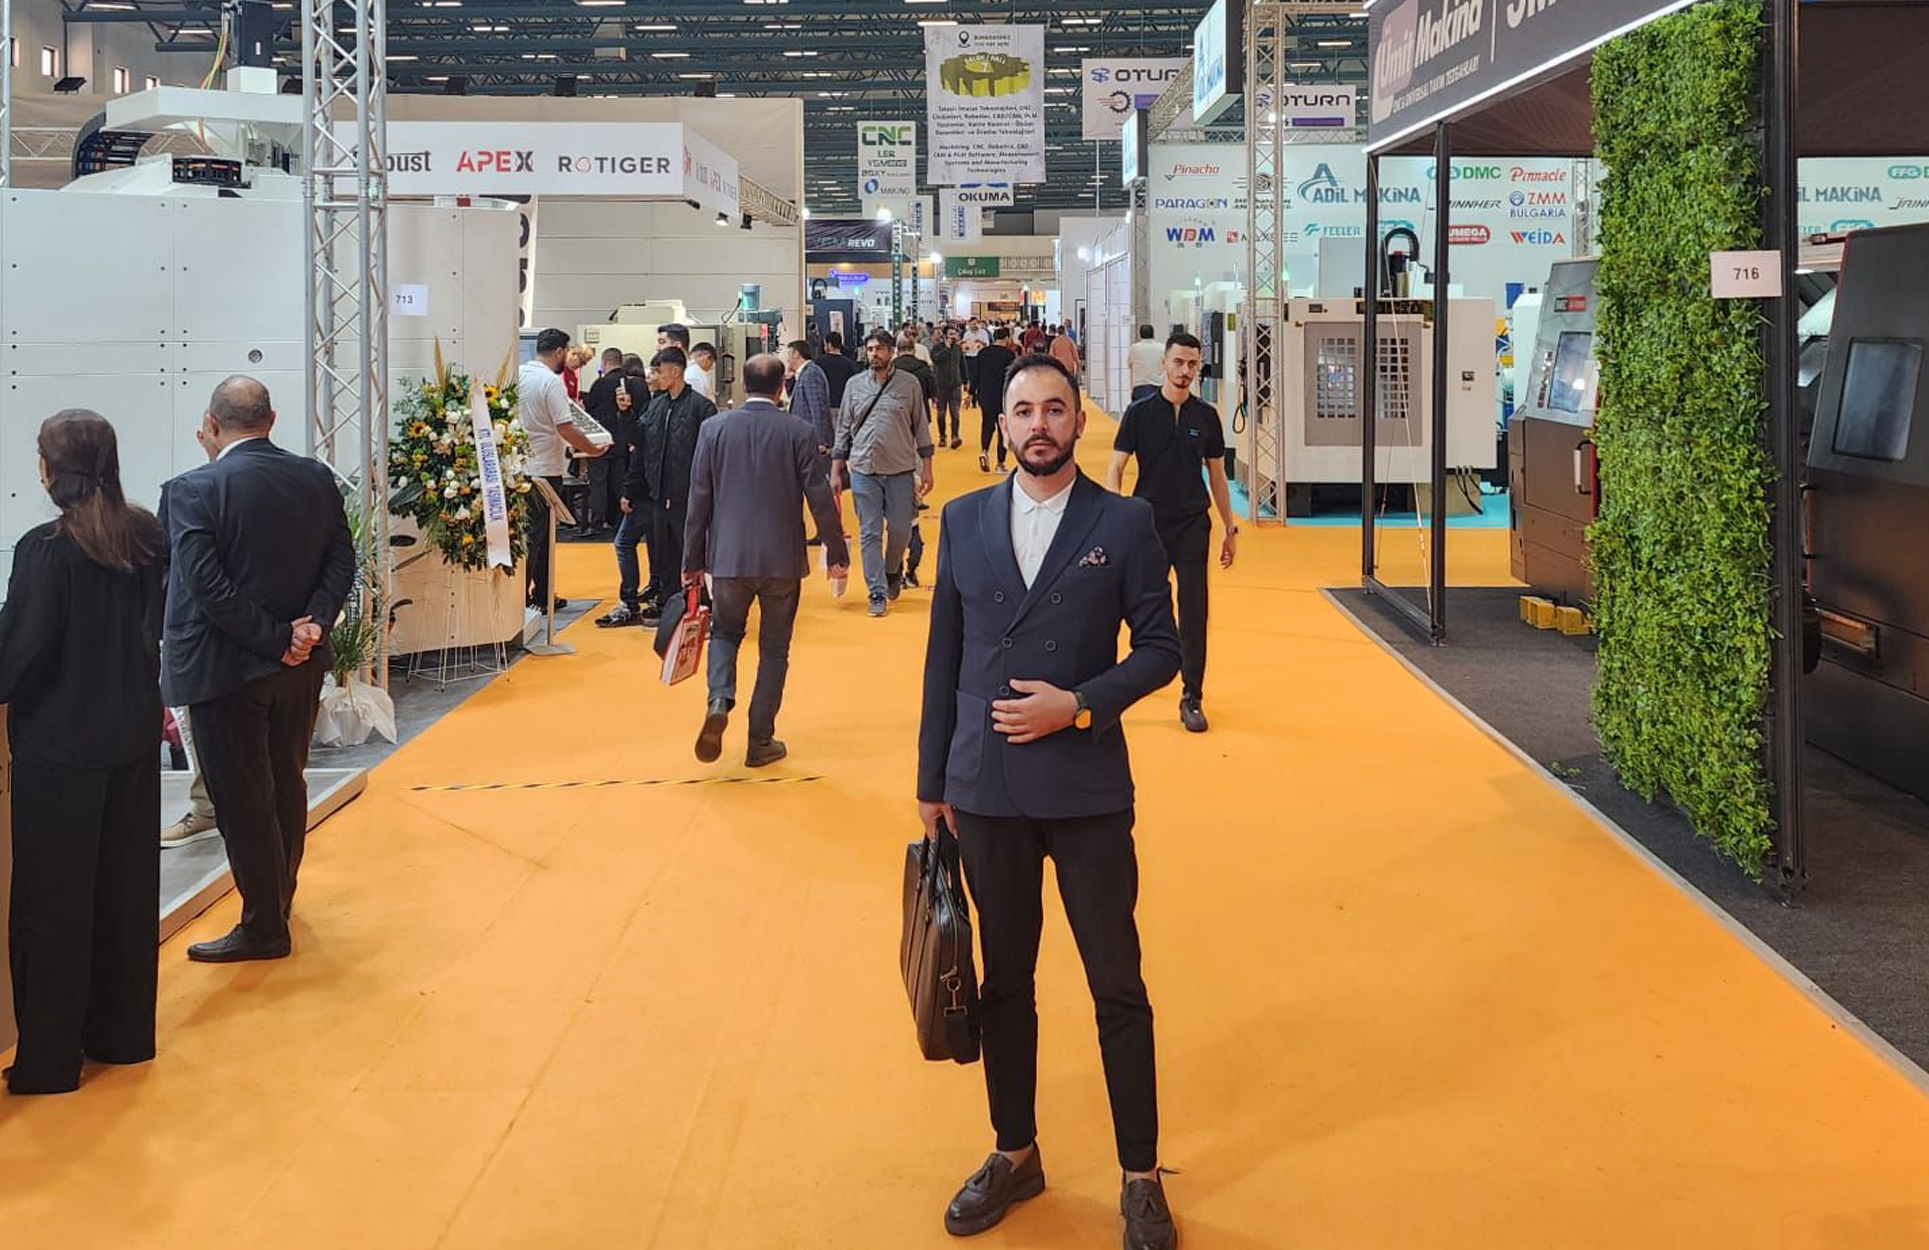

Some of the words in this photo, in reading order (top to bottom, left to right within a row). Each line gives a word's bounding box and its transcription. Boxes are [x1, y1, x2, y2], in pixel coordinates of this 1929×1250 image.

[1414, 0, 1482, 68] Makina
[862, 126, 912, 146] CNC
[456, 151, 534, 173] APEX
[557, 156, 671, 174] ROTIGER
[1172, 163, 1220, 175] Pinacho
[1463, 166, 1501, 179] DMC
[1509, 166, 1567, 182] Pinnacle
[958, 192, 1010, 202] OKUMA
[1528, 192, 1566, 204] ZMM
[1510, 208, 1566, 218] BULGARIA
[847, 239, 876, 247] REVO
[1733, 267, 1760, 280] 716
[395, 295, 413, 304] 713
